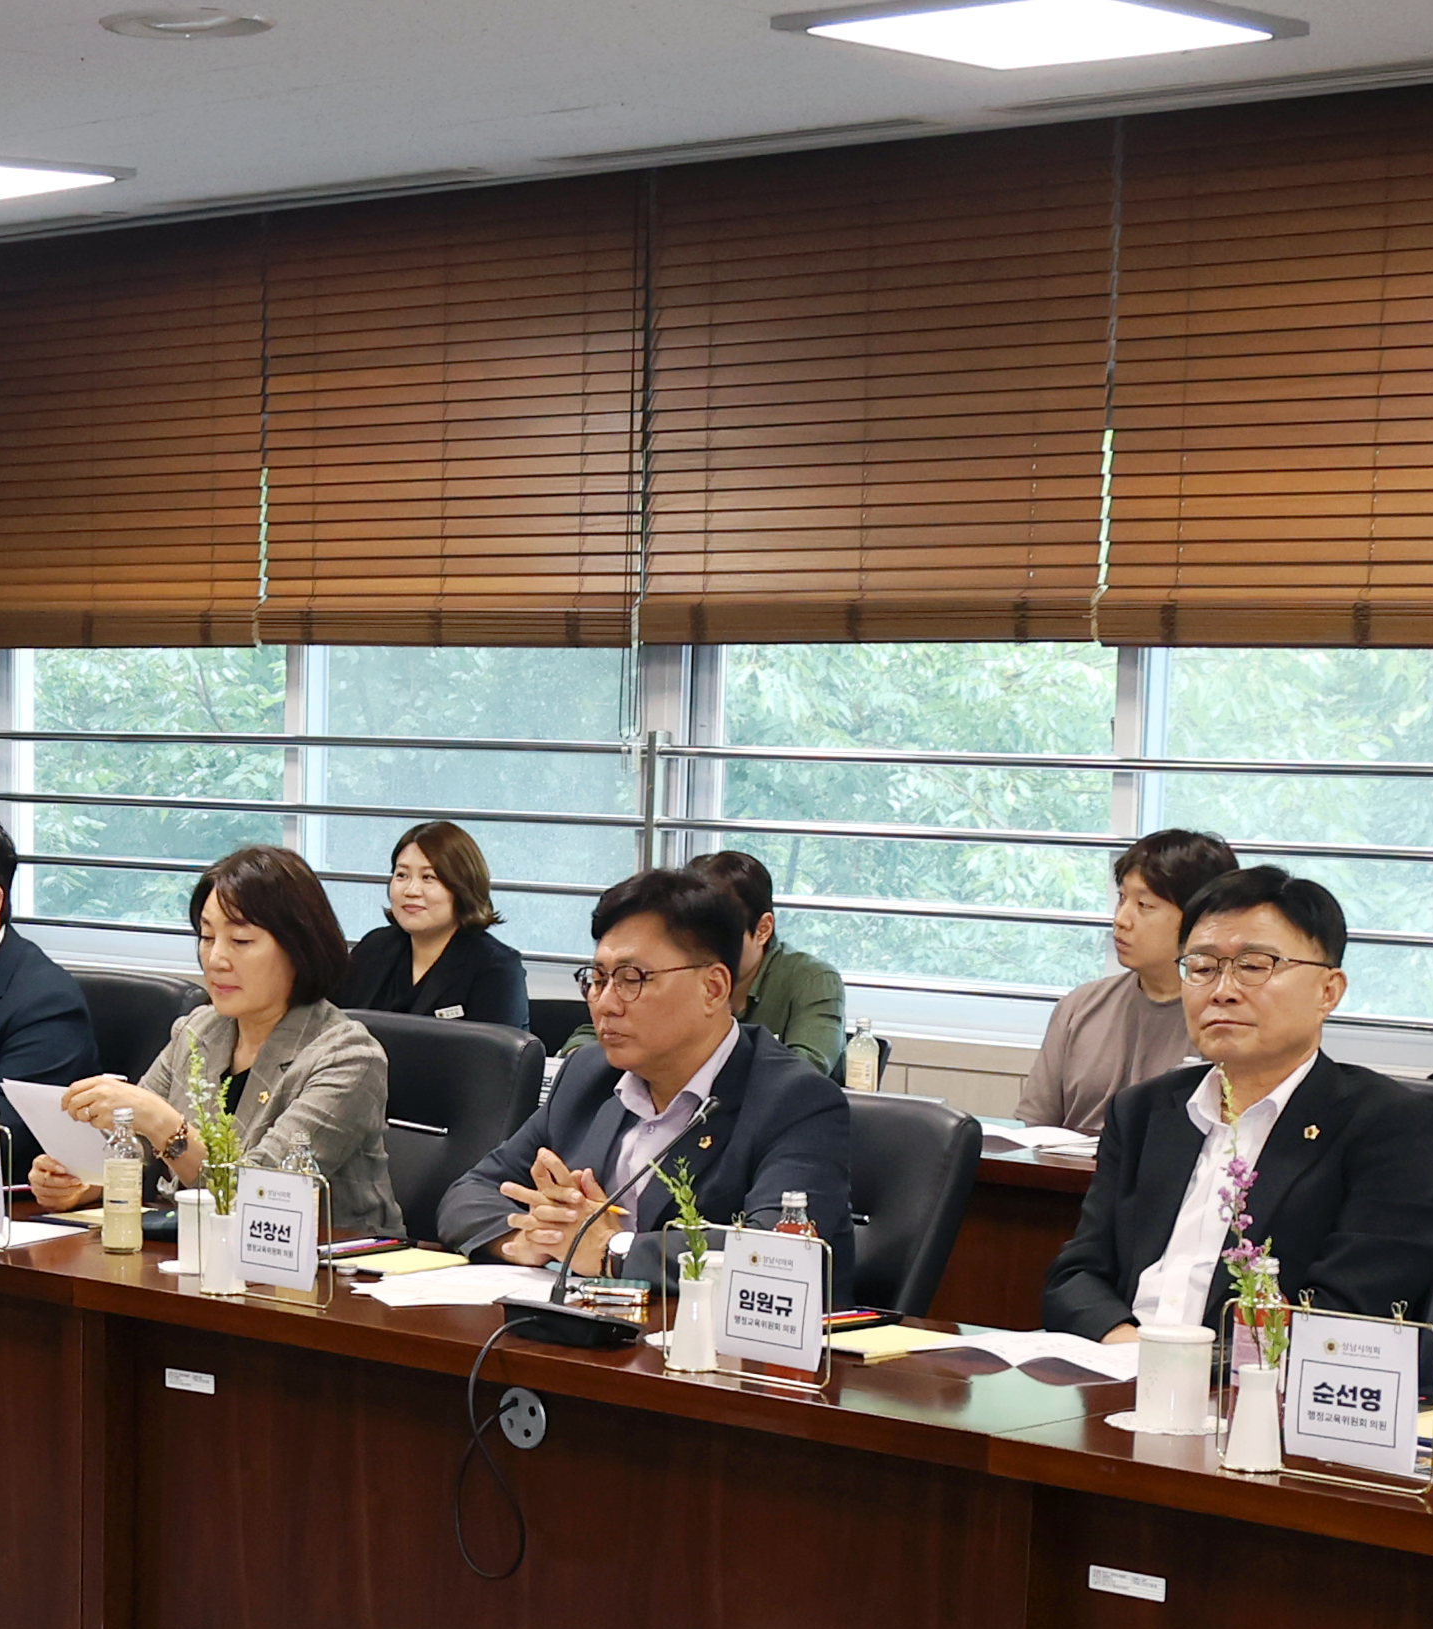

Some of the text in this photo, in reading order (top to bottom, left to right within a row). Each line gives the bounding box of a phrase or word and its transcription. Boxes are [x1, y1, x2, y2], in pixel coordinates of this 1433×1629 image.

[249, 1219, 291, 1244] 선창선
[739, 1288, 793, 1317] 임원규
[734, 1315, 797, 1335] 행정교육위원회 의원
[1342, 1341, 1381, 1355] 성남시의회
[1312, 1381, 1382, 1412] 순선영
[1307, 1409, 1387, 1431] 행정교육위원회 의원
